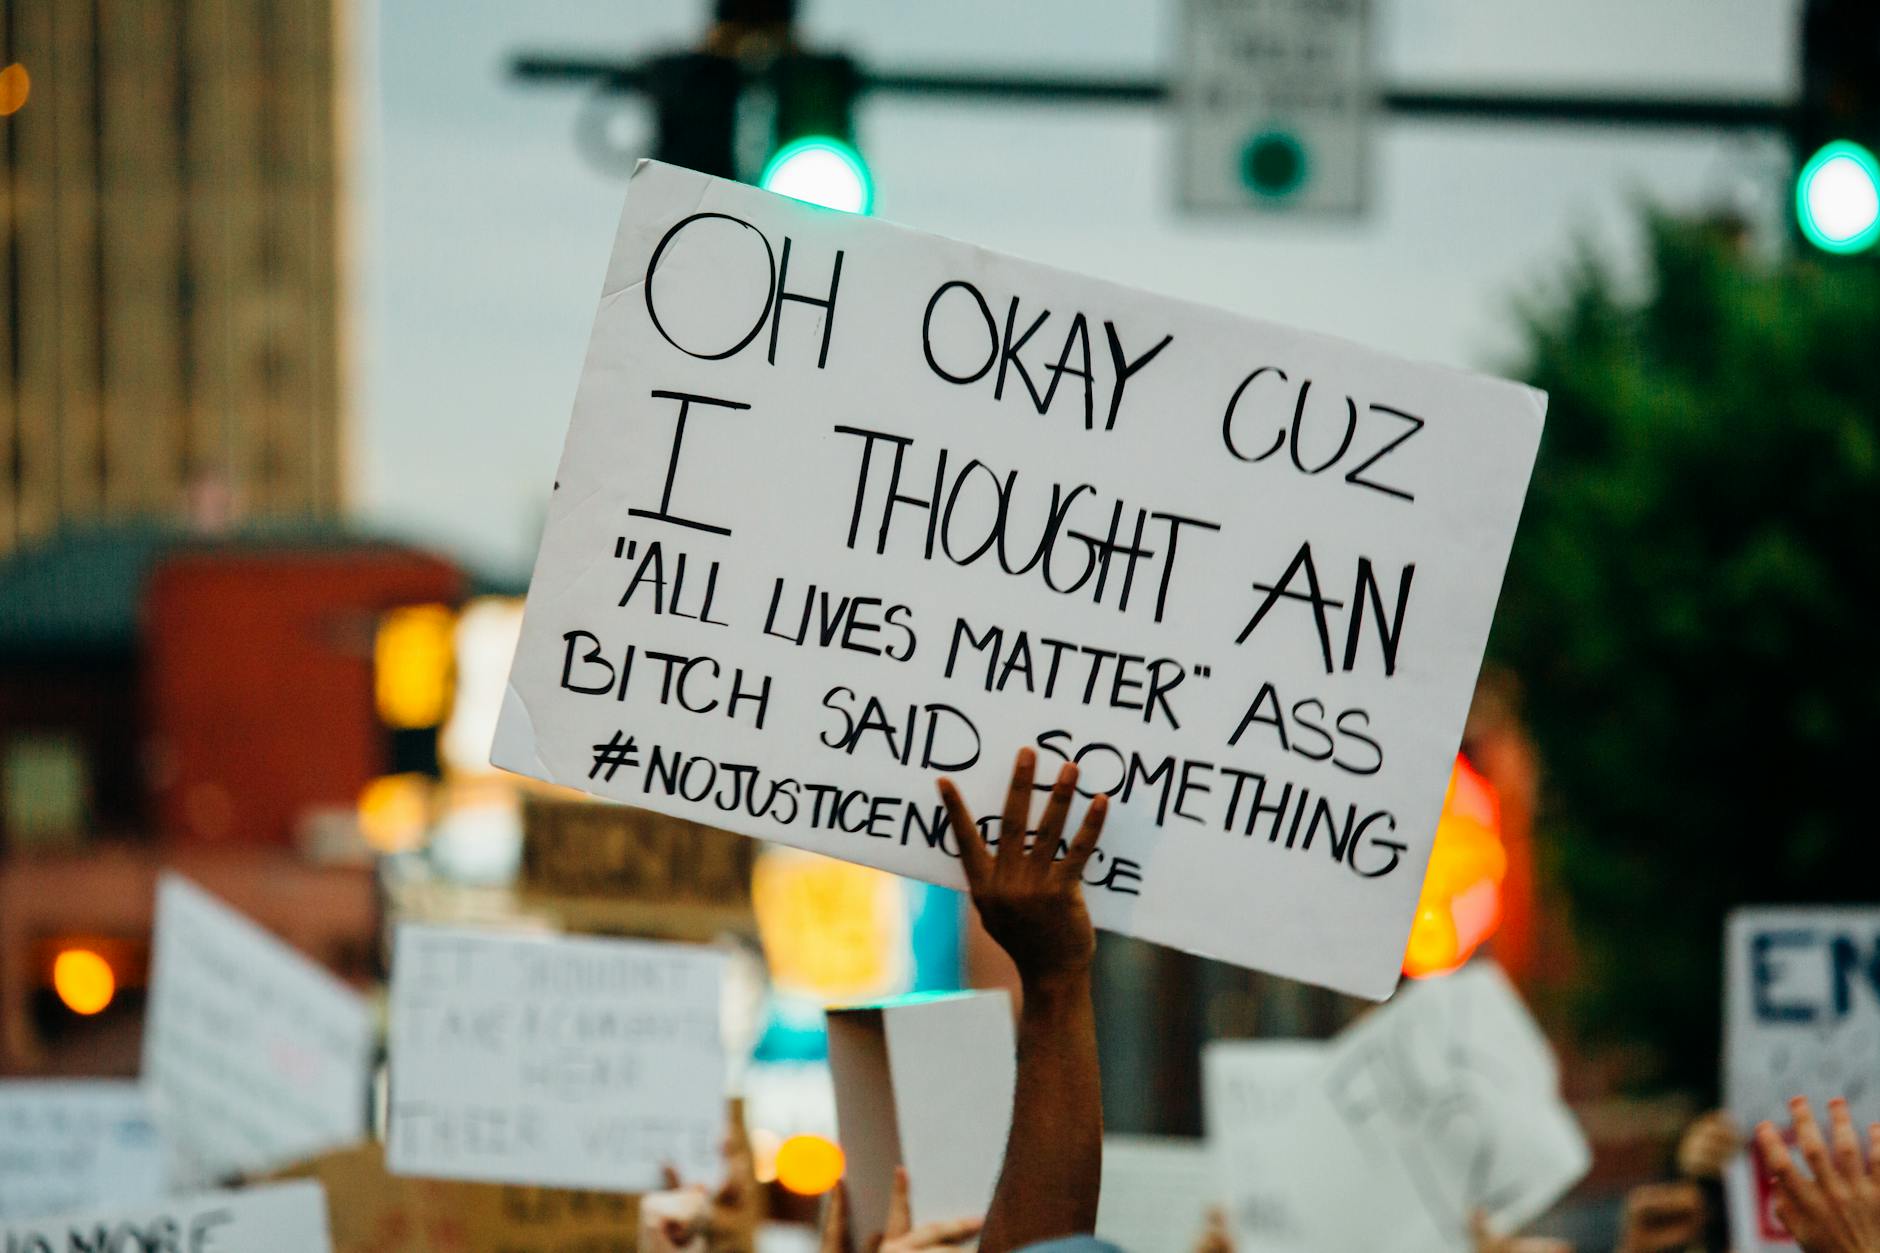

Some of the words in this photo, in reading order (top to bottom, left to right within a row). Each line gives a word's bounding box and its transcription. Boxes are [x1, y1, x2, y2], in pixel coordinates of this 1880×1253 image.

[645, 212, 844, 370] OH
[922, 280, 1173, 430] OKAY
[1222, 366, 1424, 503] CUZ
[614, 536, 729, 627] "ALL
[763, 578, 917, 662] LIVES
[944, 617, 1212, 730] MATTER"
[1227, 682, 1383, 776] ASS
[628, 389, 752, 537] I
[834, 424, 1221, 623] THOUGHT
[1234, 540, 1416, 676] AN
[560, 630, 772, 730] BITCH
[820, 686, 981, 772] SAID
[1030, 729, 1408, 878] SOMETHING
